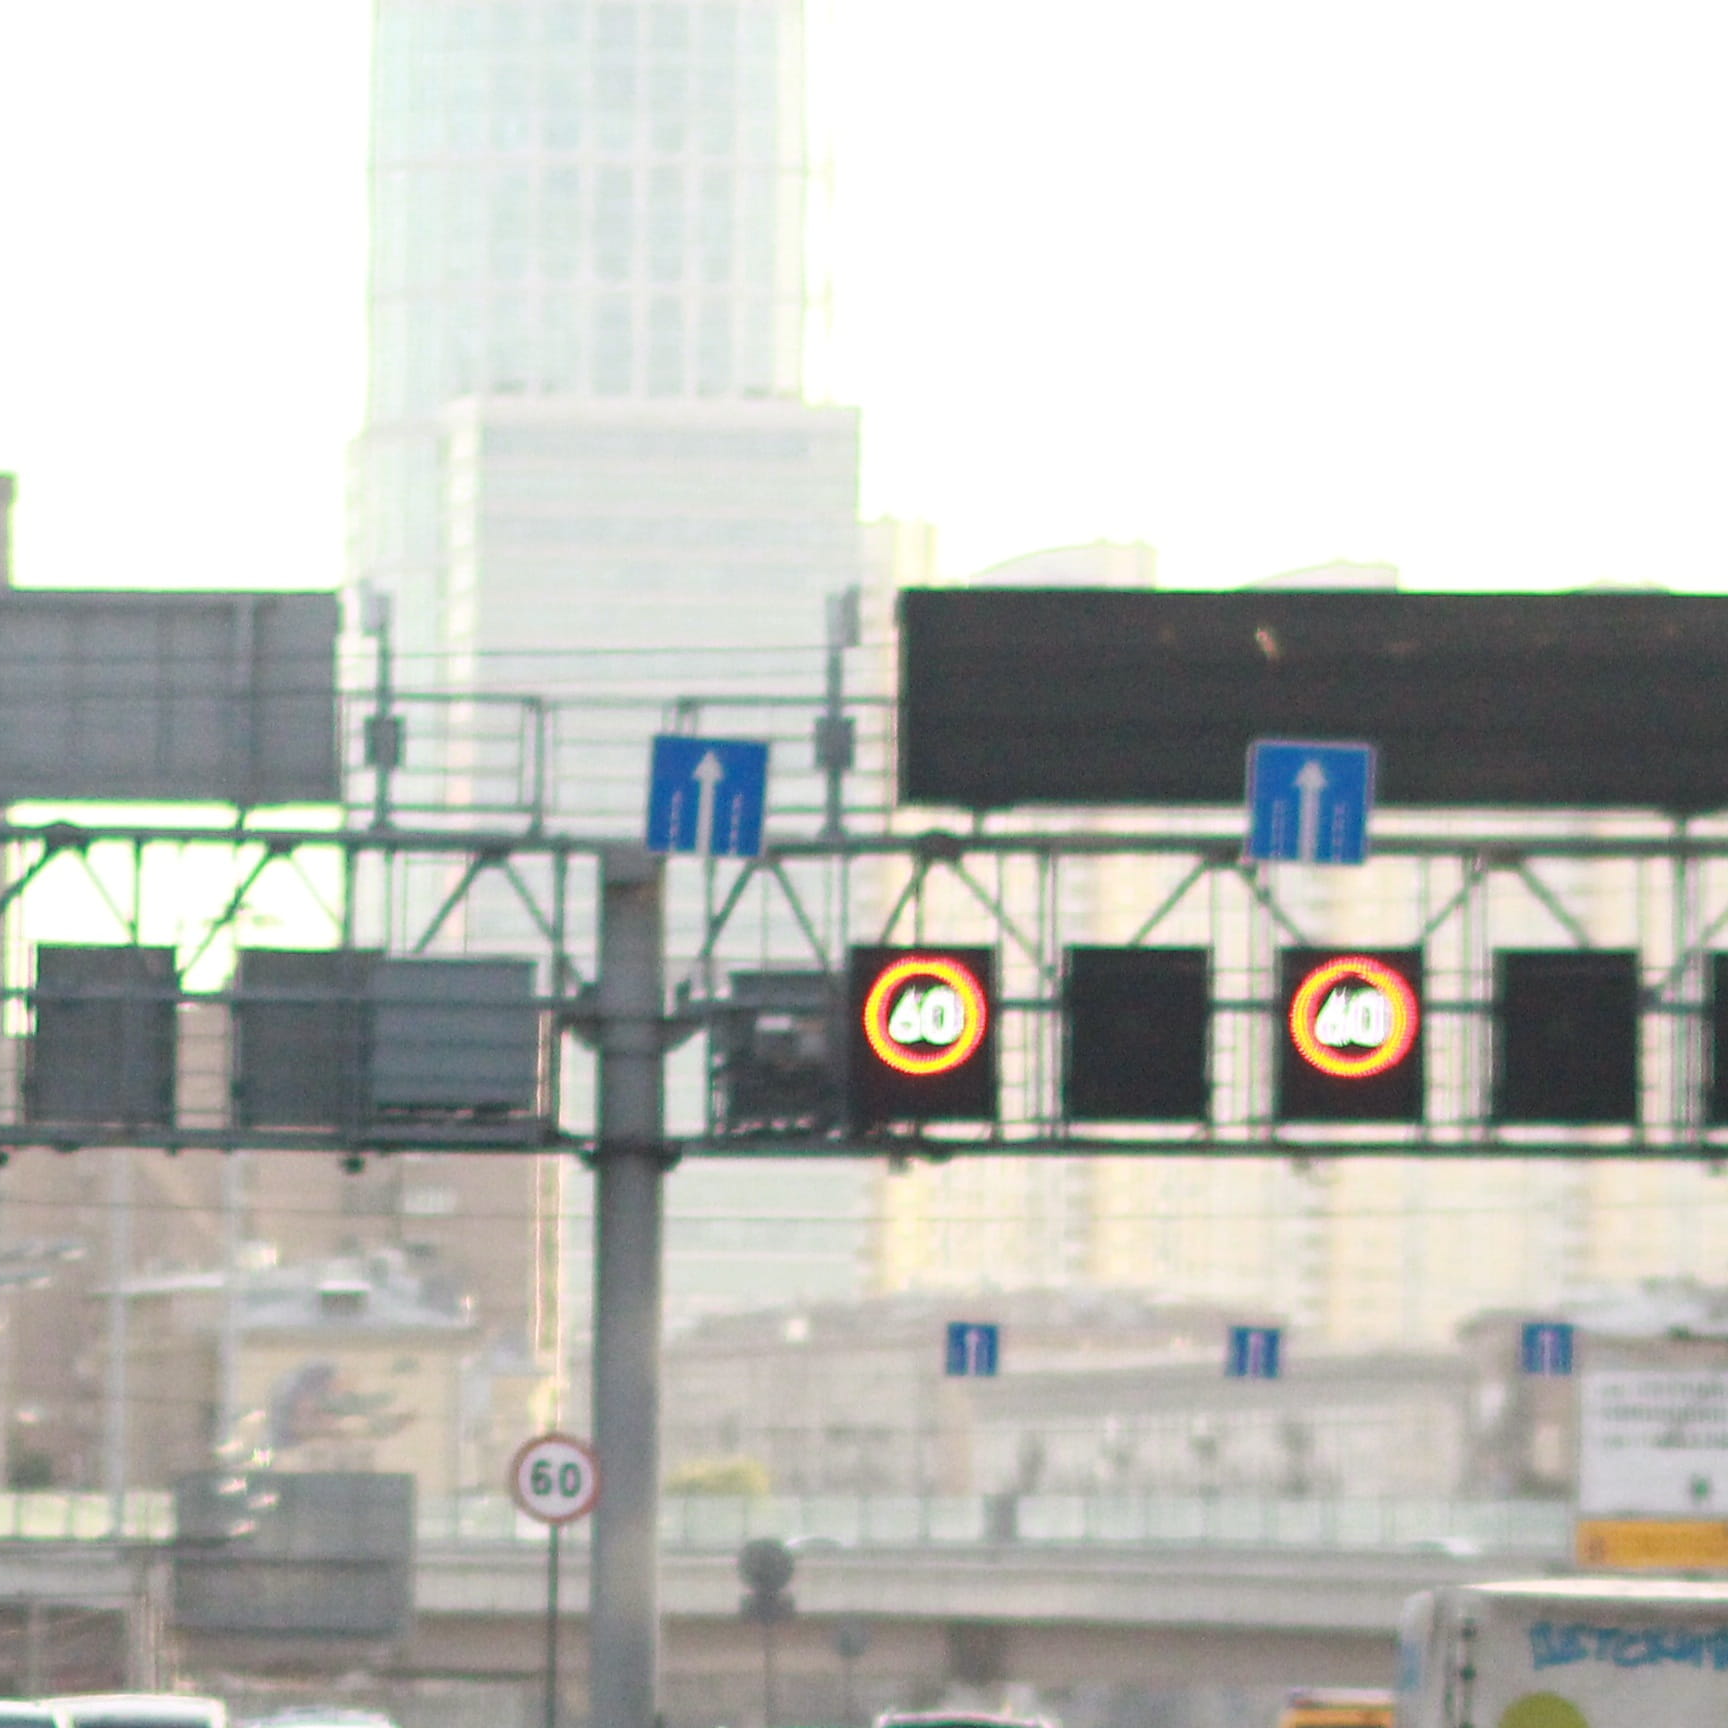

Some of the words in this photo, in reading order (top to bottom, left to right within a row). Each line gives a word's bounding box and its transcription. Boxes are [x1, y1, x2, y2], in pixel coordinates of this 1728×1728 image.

[888, 983, 966, 1046] 60
[1314, 986, 1396, 1048] 60
[531, 1459, 582, 1498] 60
